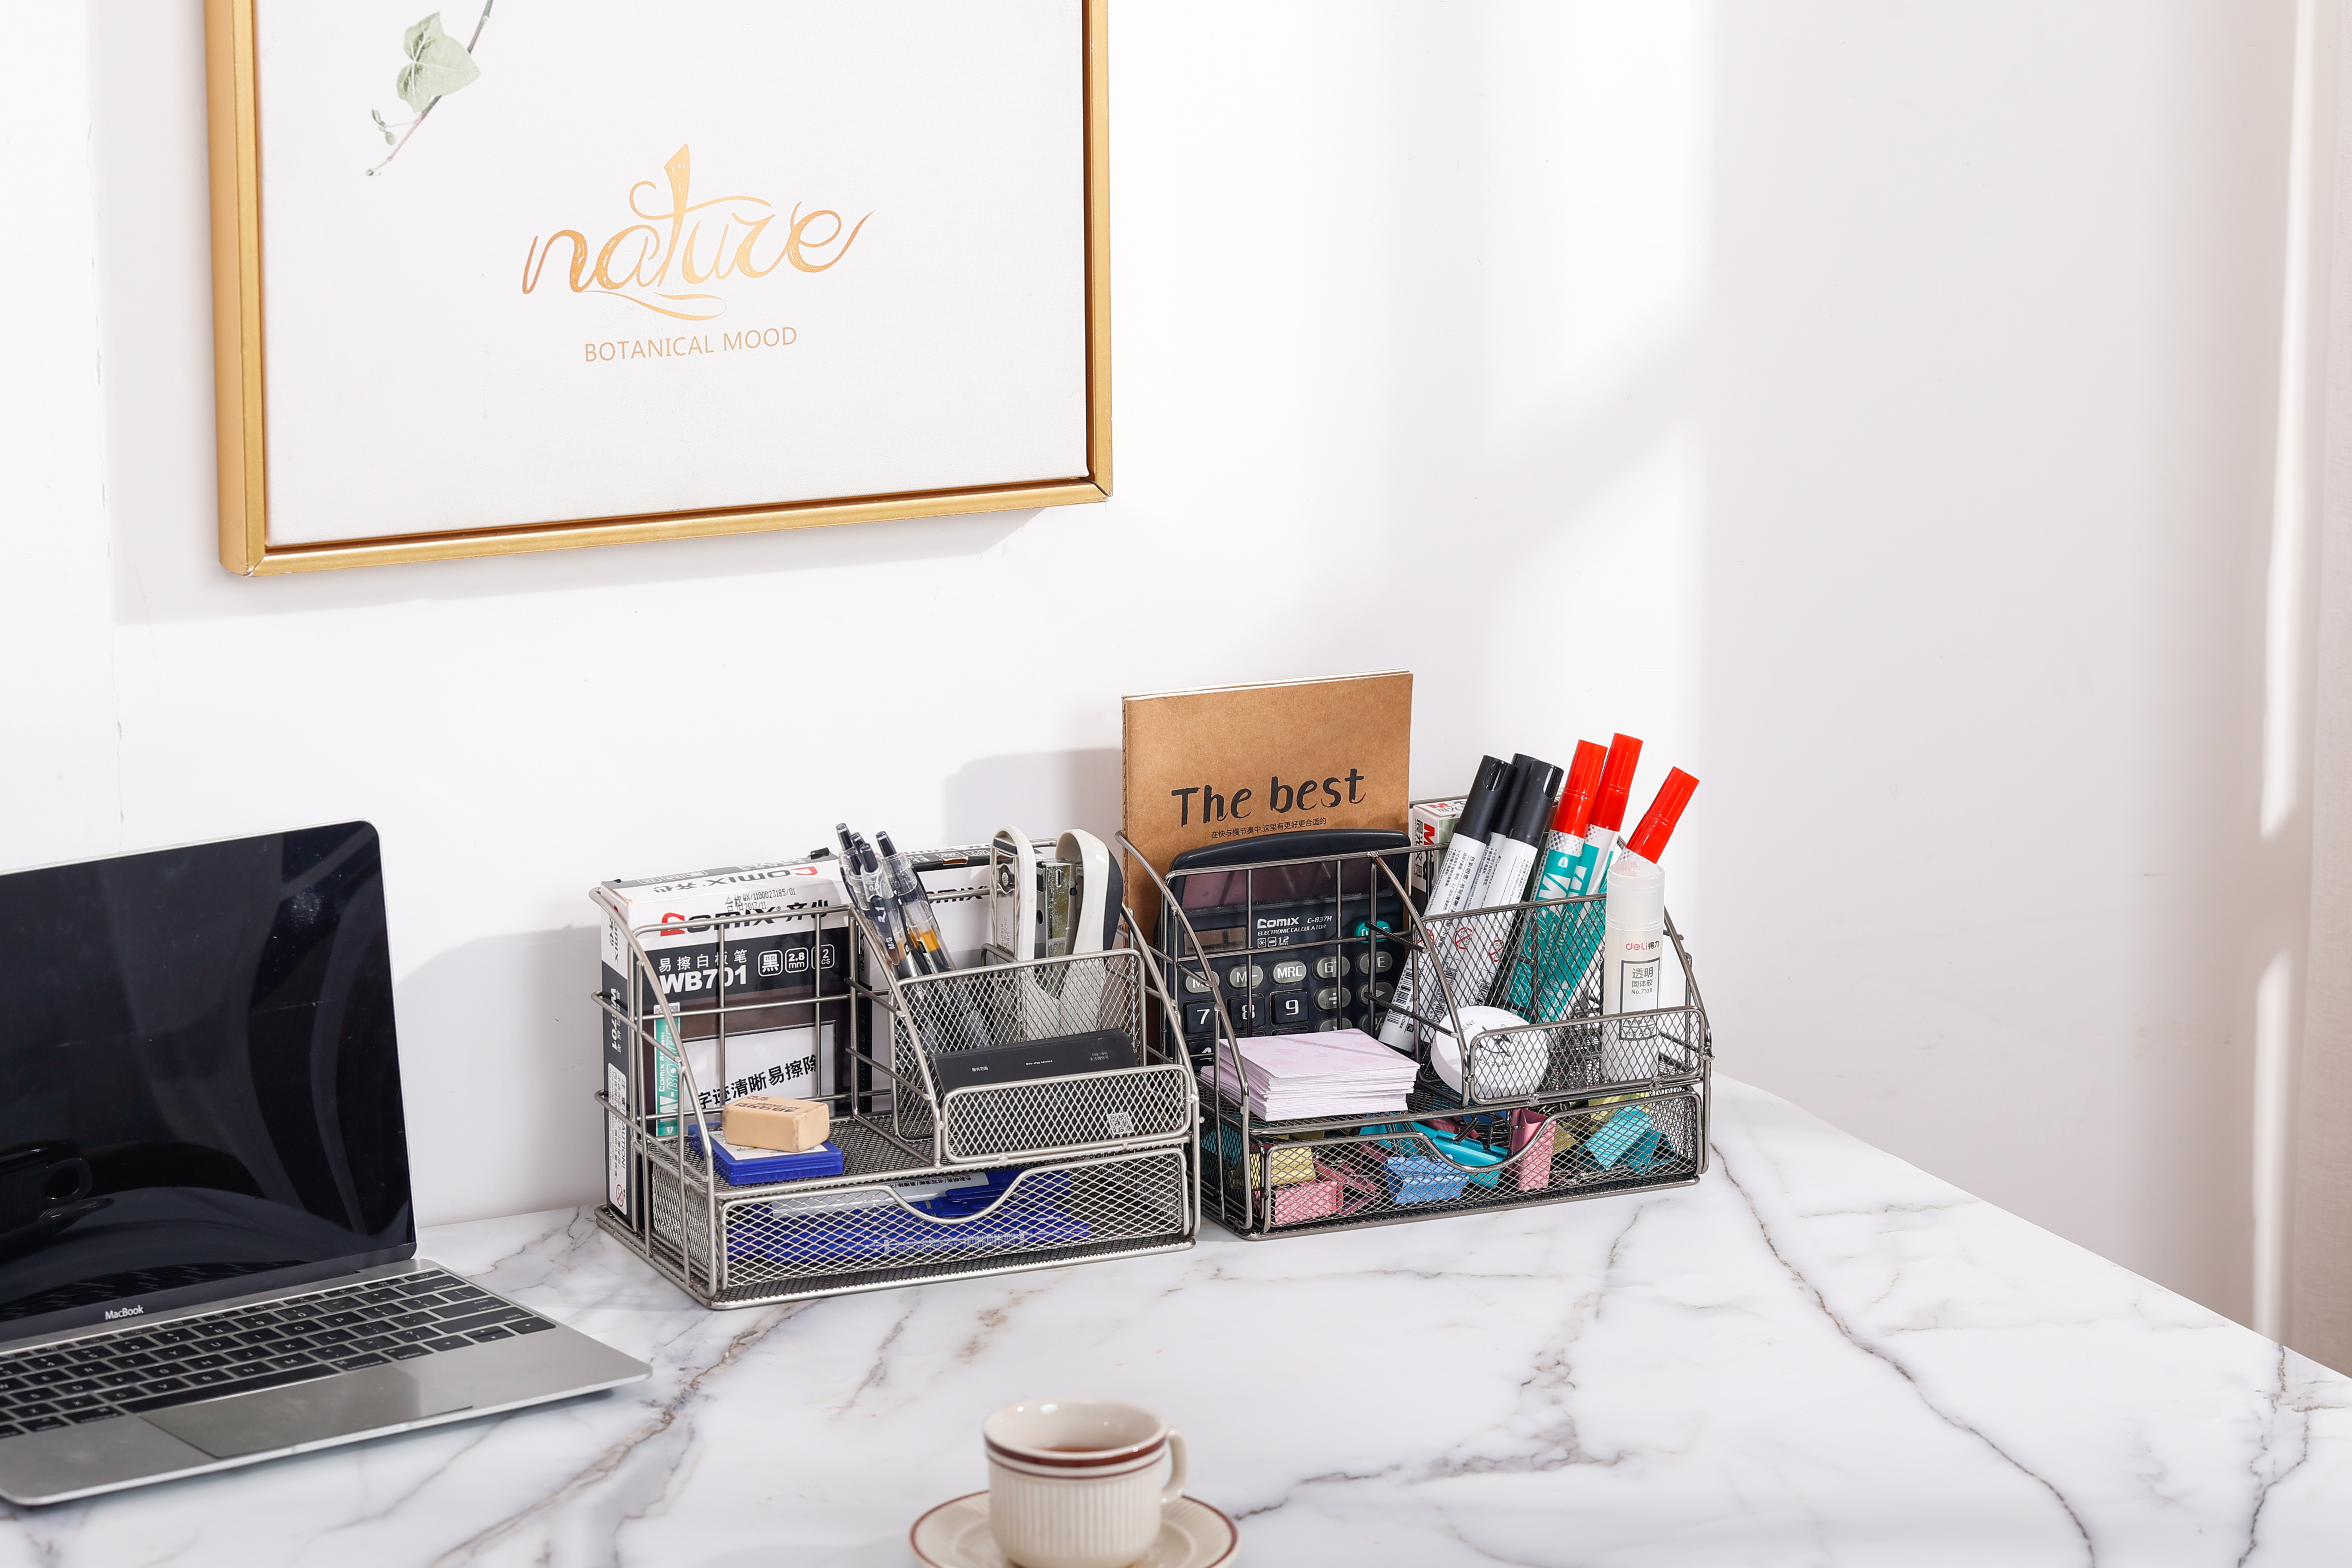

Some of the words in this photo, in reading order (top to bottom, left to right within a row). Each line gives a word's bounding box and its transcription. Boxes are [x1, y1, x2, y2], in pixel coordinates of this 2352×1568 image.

[522, 143, 876, 321] nature
[585, 335, 714, 362] BOTANICAL
[723, 326, 797, 352] MOOD
[1171, 784, 1252, 827] The
[1270, 768, 1367, 813] best
[1258, 928, 1289, 936] ELECTRONIC
[1291, 924, 1327, 933] CALCULATOR
[762, 954, 779, 973] 黑
[788, 952, 805, 962] 2.8
[1277, 965, 1303, 979] MRC
[1632, 966, 1654, 979] 透明
[1631, 979, 1653, 988] 固体胶
[1196, 1008, 1210, 1024] 7
[1285, 1000, 1299, 1016] 9
[105, 1305, 144, 1320] MacBook
